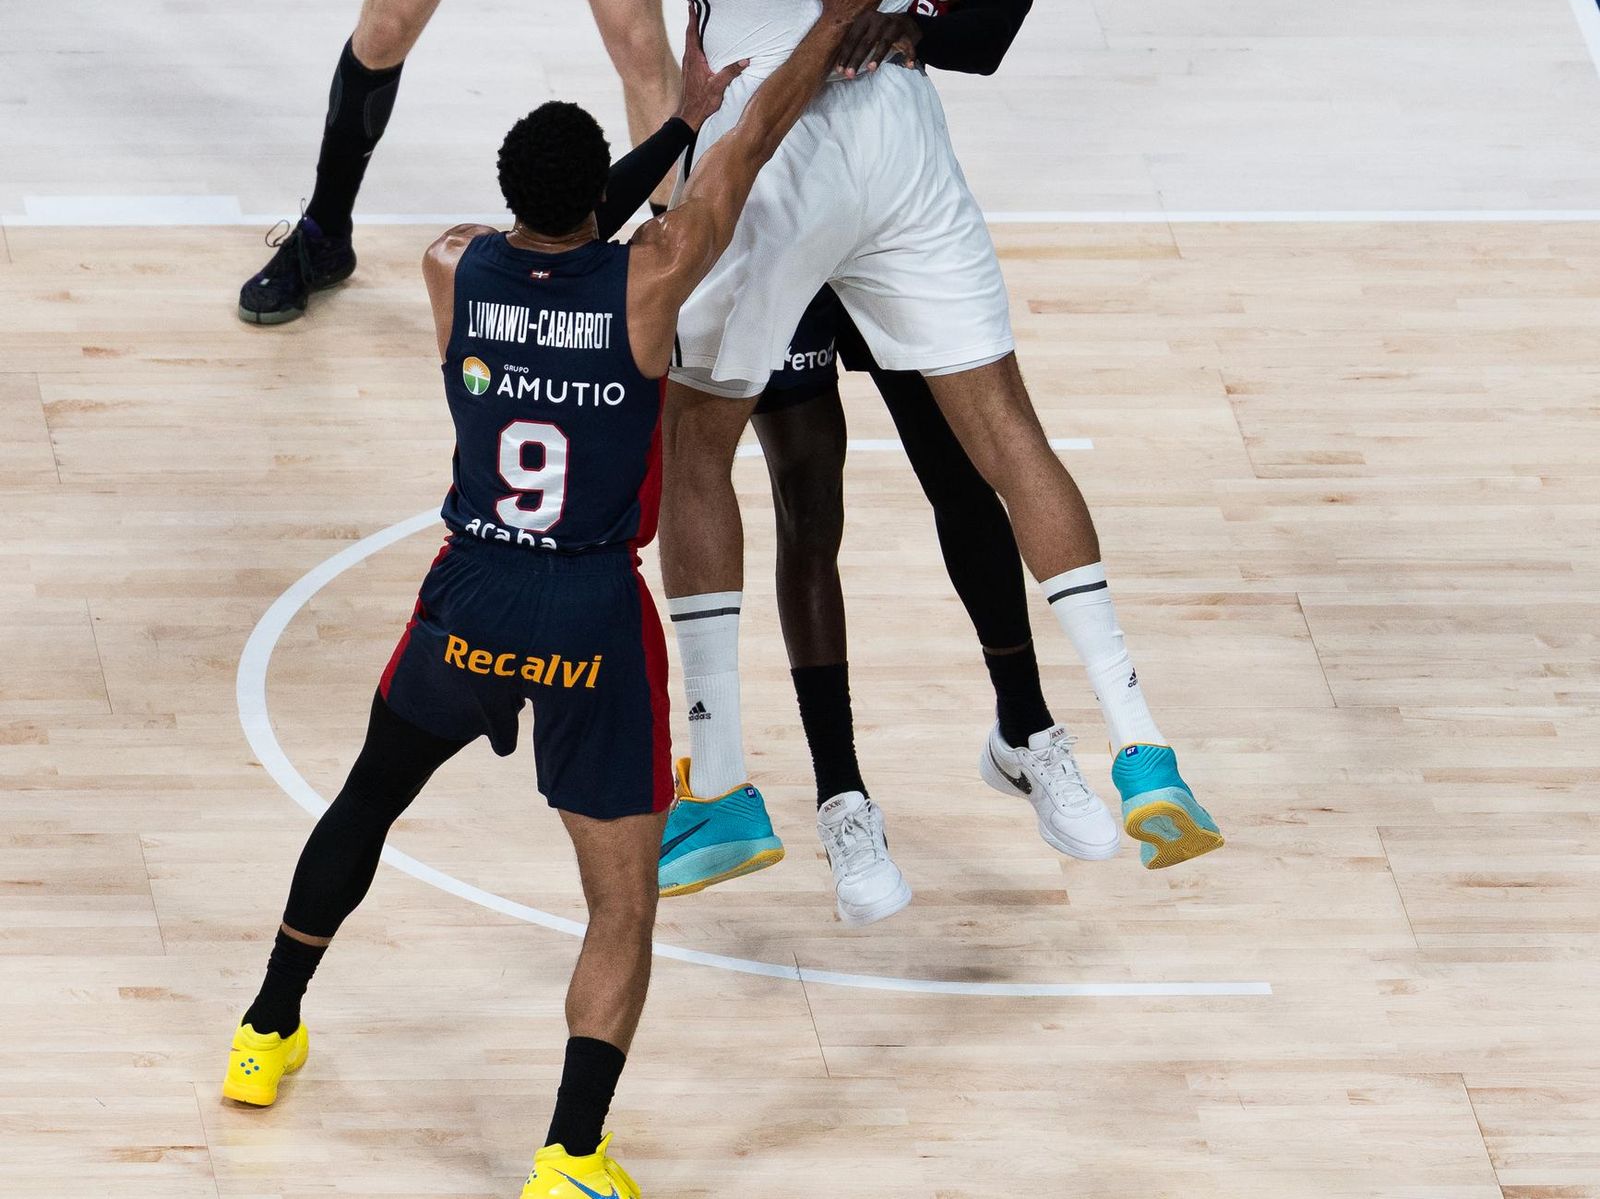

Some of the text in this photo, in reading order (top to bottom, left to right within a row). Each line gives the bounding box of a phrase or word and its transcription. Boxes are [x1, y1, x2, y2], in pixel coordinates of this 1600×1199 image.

[468, 301, 612, 349] LUWAWU-CABARROT
[496, 373, 625, 407] AMUTIO
[503, 364, 529, 374] GRUPO
[495, 418, 570, 534] 9
[443, 634, 603, 690] Recalvi
